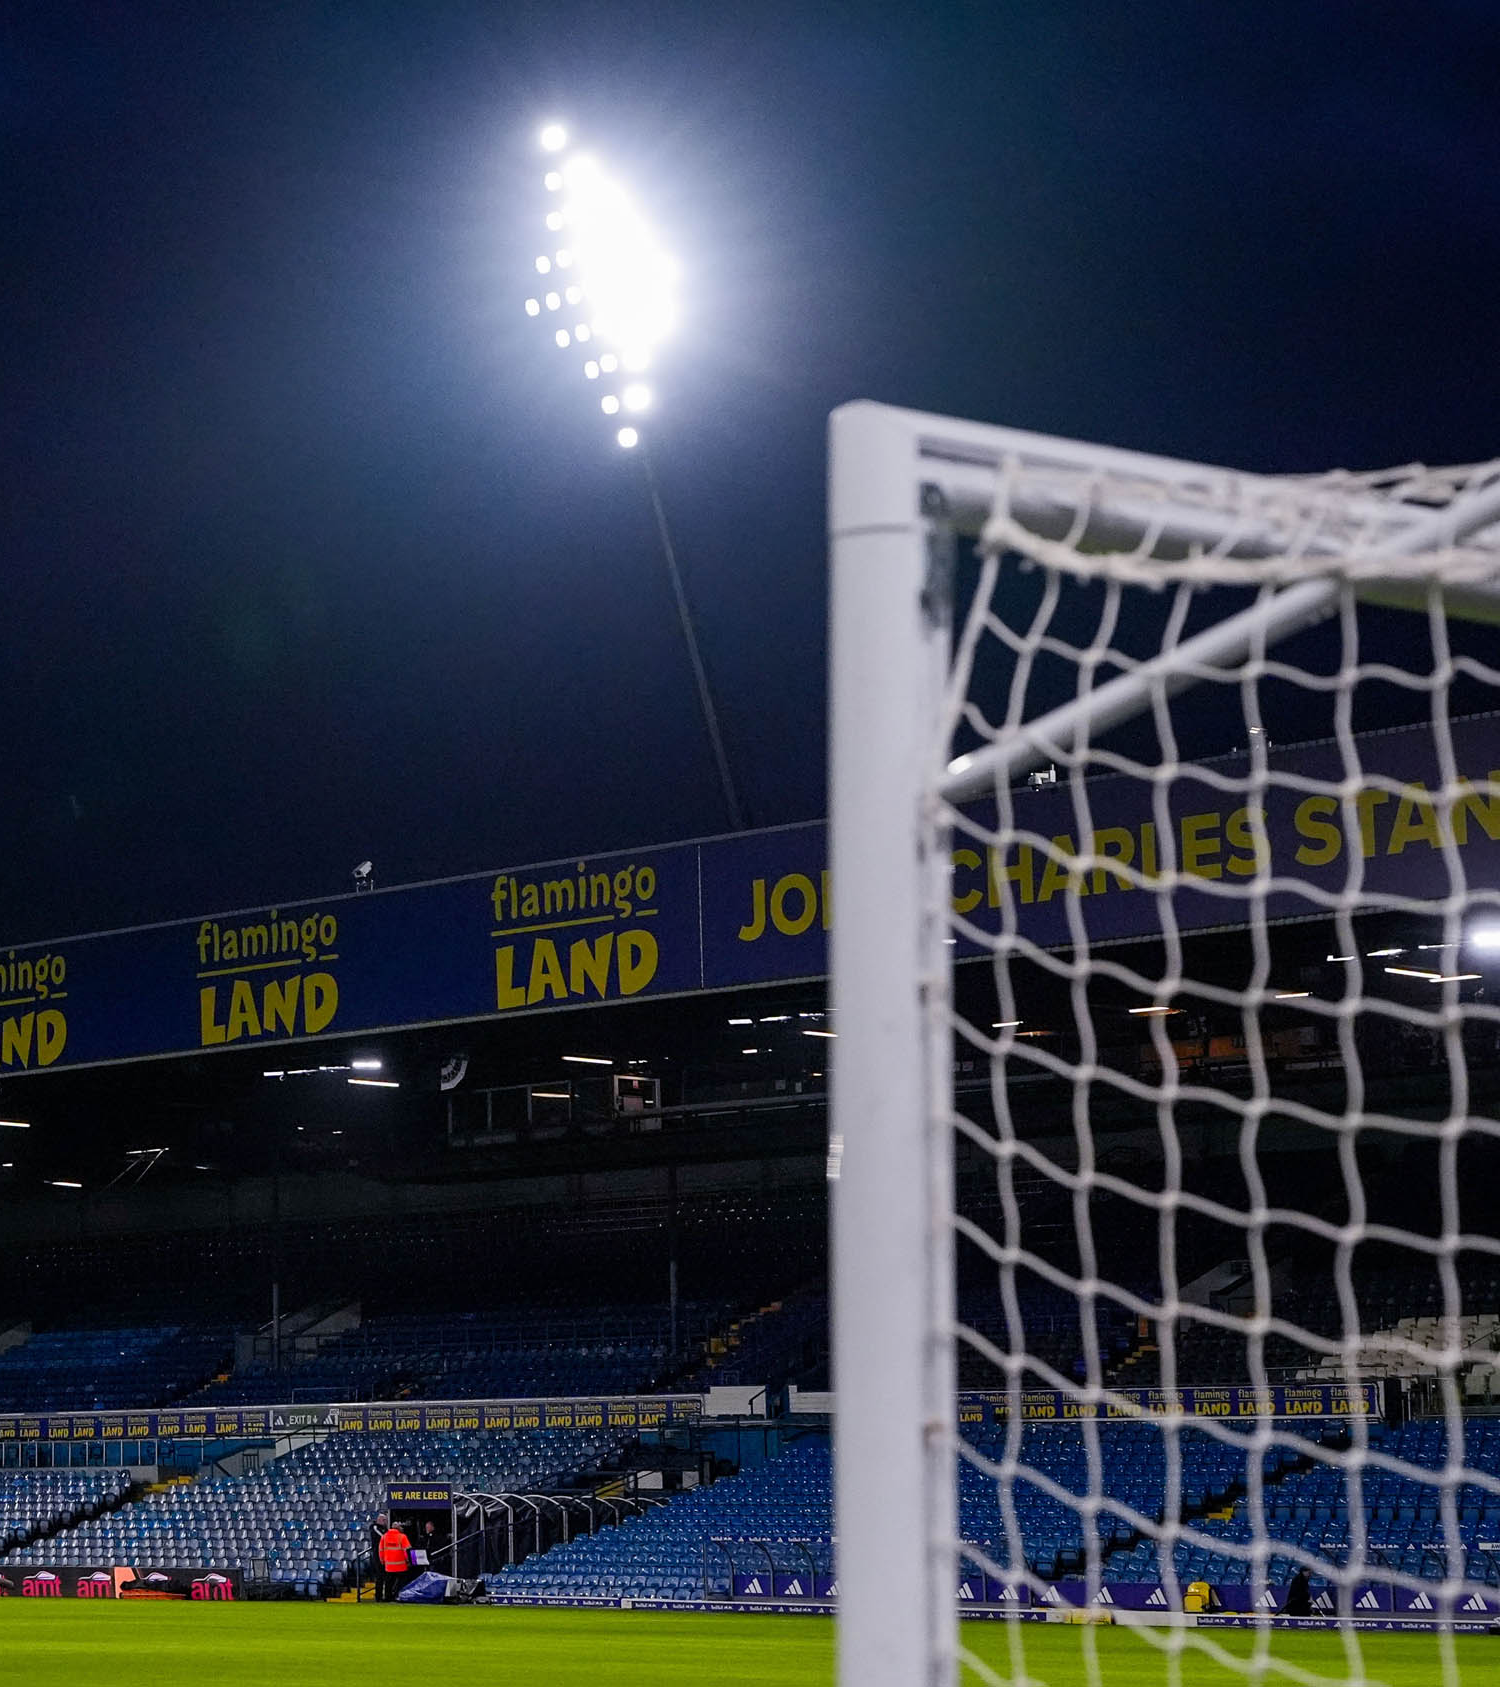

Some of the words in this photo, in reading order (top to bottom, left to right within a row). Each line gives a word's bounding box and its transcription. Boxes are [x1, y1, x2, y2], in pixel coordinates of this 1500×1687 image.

[491, 862, 657, 919] flamingo
[738, 869, 829, 942] JO
[197, 910, 337, 963] flamingo
[495, 929, 658, 1010] LAND
[198, 972, 339, 1046] LAND
[1193, 1390, 1230, 1401] flamingo
[1284, 1388, 1322, 1399] flamingo
[1022, 1405, 1056, 1418] LAND
[1194, 1402, 1231, 1415] LAND
[1285, 1400, 1323, 1414] LAND
[290, 1415, 305, 1424] EXIT
[368, 1419, 393, 1430] LAND
[396, 1419, 420, 1430] LAND
[426, 1418, 451, 1430] LAND
[453, 1418, 479, 1429] LAND
[484, 1417, 510, 1428] LAND
[513, 1416, 539, 1427] LAND
[545, 1416, 572, 1427] LAND
[575, 1415, 602, 1426] LAND
[608, 1414, 636, 1426] LAND
[102, 1426, 124, 1436] LAND
[128, 1426, 148, 1436] LAND
[158, 1424, 180, 1436] LAND
[184, 1424, 206, 1434] LAND
[215, 1424, 238, 1434] LAND
[339, 1420, 362, 1431] LAND
[20, 1428, 40, 1438] LAND
[48, 1428, 68, 1438] LAND
[73, 1428, 94, 1438] LAND
[390, 1491, 403, 1500] WE
[405, 1491, 421, 1500] ARE
[422, 1491, 448, 1500] LEEDS
[22, 1575, 62, 1597] amt
[191, 1578, 235, 1600] amt
